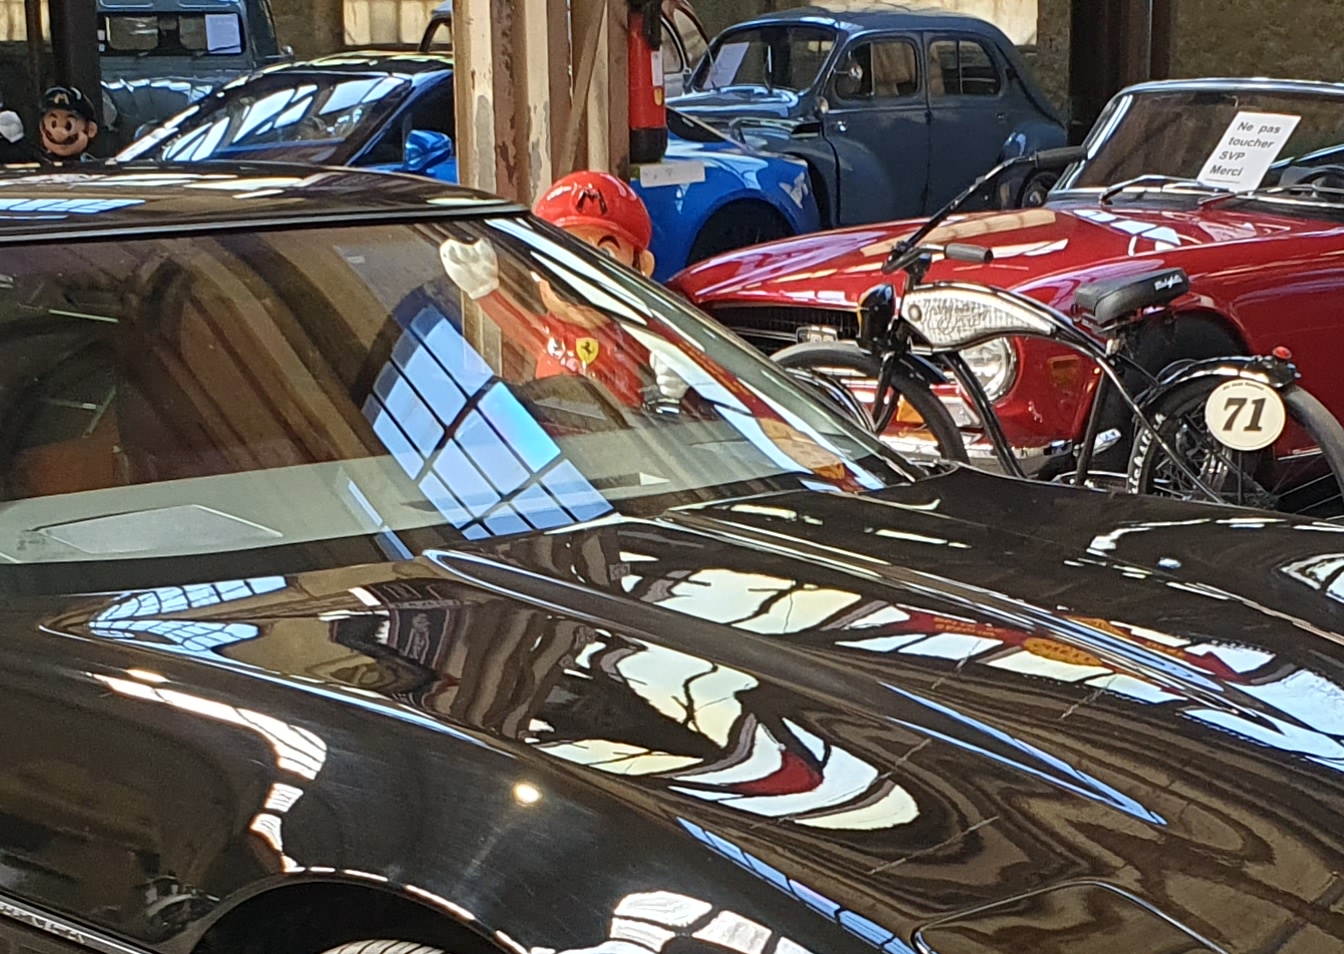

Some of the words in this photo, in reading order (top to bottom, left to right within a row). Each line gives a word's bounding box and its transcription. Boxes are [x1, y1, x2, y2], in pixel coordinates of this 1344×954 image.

[1237, 121, 1254, 132] Ne
[1257, 125, 1281, 135] pas
[1228, 137, 1274, 149] toucher
[1219, 151, 1245, 161] SVP
[1209, 165, 1244, 177] Merci
[576, 186, 608, 215] M
[1222, 397, 1266, 432] 71
